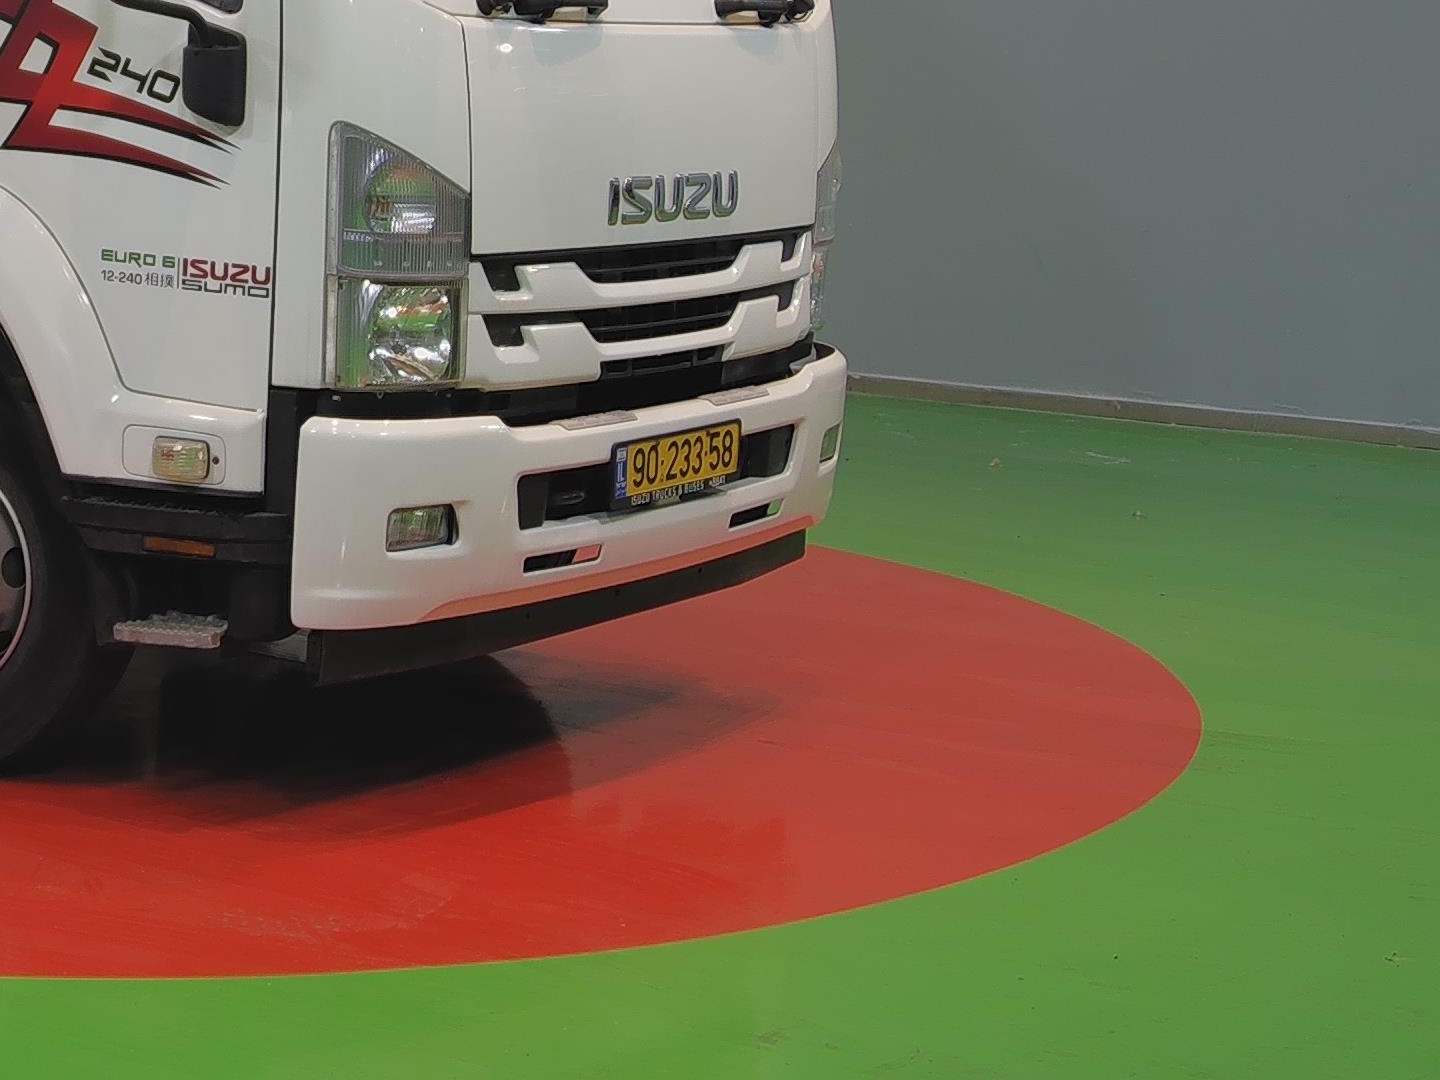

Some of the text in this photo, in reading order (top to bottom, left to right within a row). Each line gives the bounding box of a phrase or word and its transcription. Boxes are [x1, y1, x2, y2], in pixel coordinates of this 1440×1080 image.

[86, 46, 181, 104] 240
[607, 170, 739, 226] ISUZU
[101, 248, 176, 269] EURO 6
[100, 269, 143, 286] 12-240
[182, 257, 272, 285] ISUZU
[181, 278, 270, 299] SUMO
